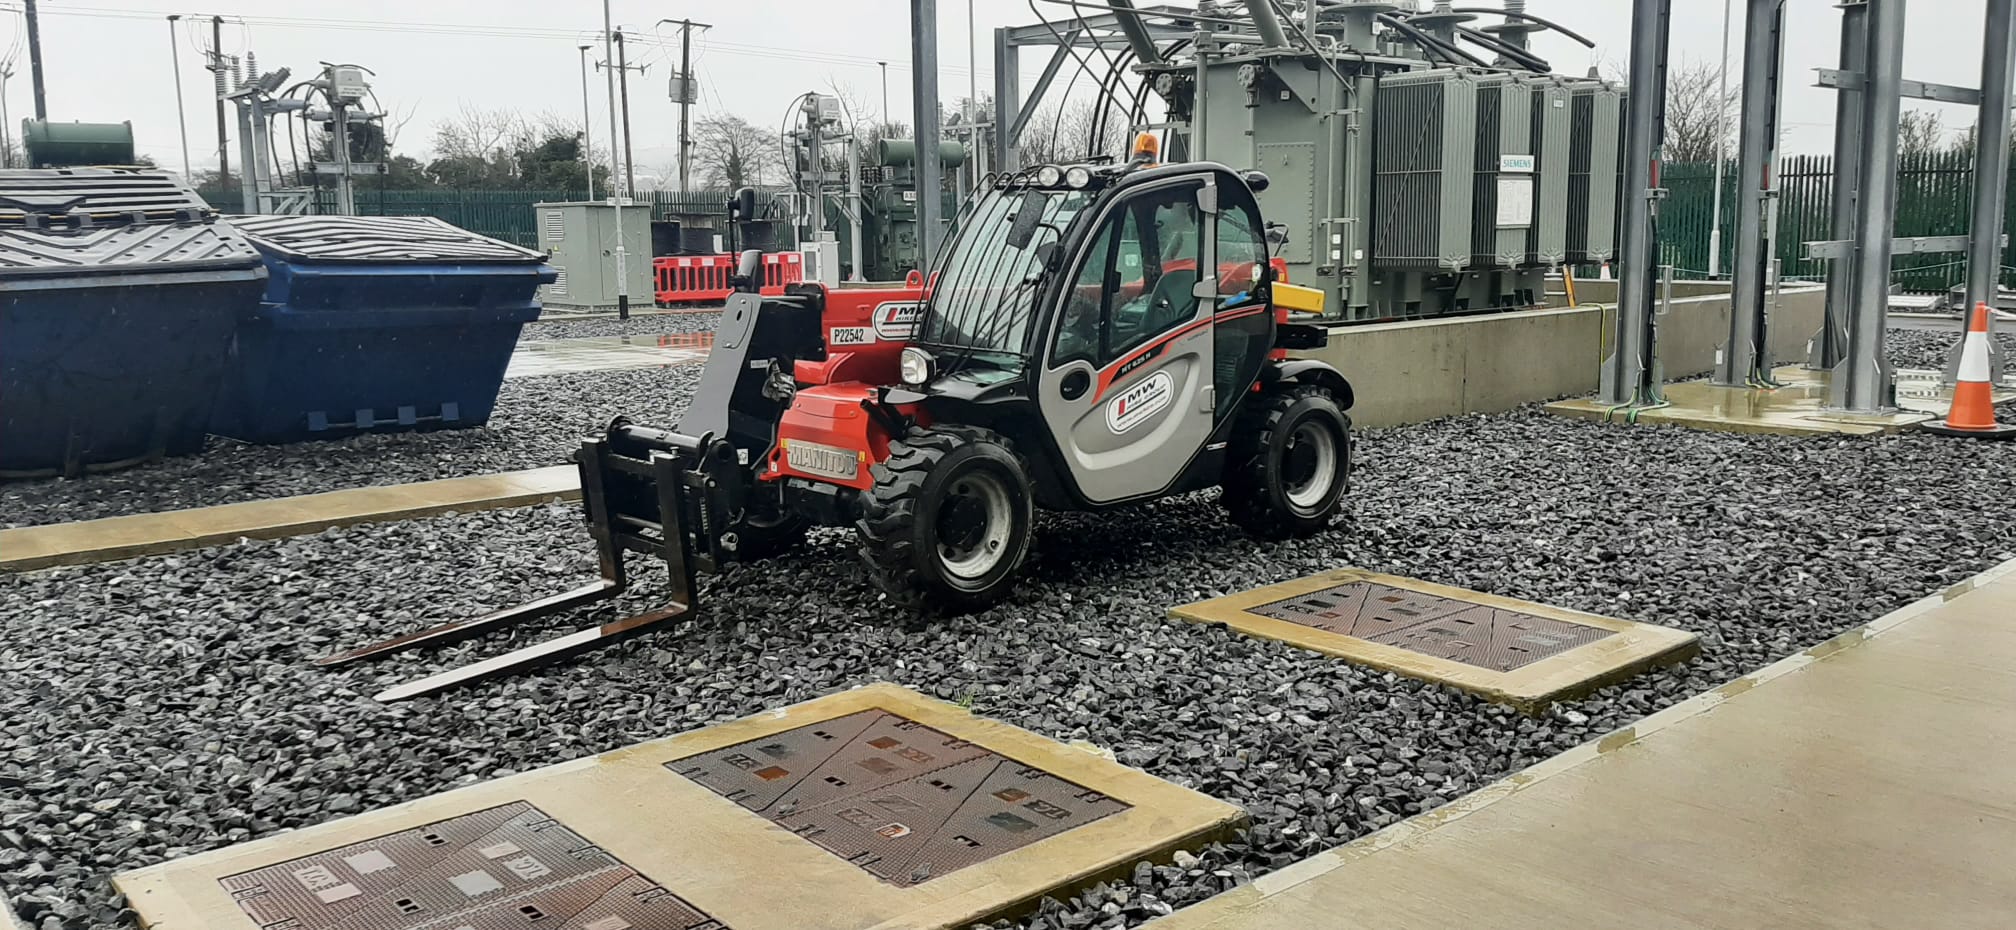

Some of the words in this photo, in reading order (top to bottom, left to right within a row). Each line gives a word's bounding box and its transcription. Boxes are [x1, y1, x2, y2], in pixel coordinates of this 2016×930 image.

[1503, 159, 1531, 168] SIEMENS
[834, 328, 864, 343] P22542
[1127, 378, 1157, 403] MW
[788, 443, 857, 475] MANITOU
